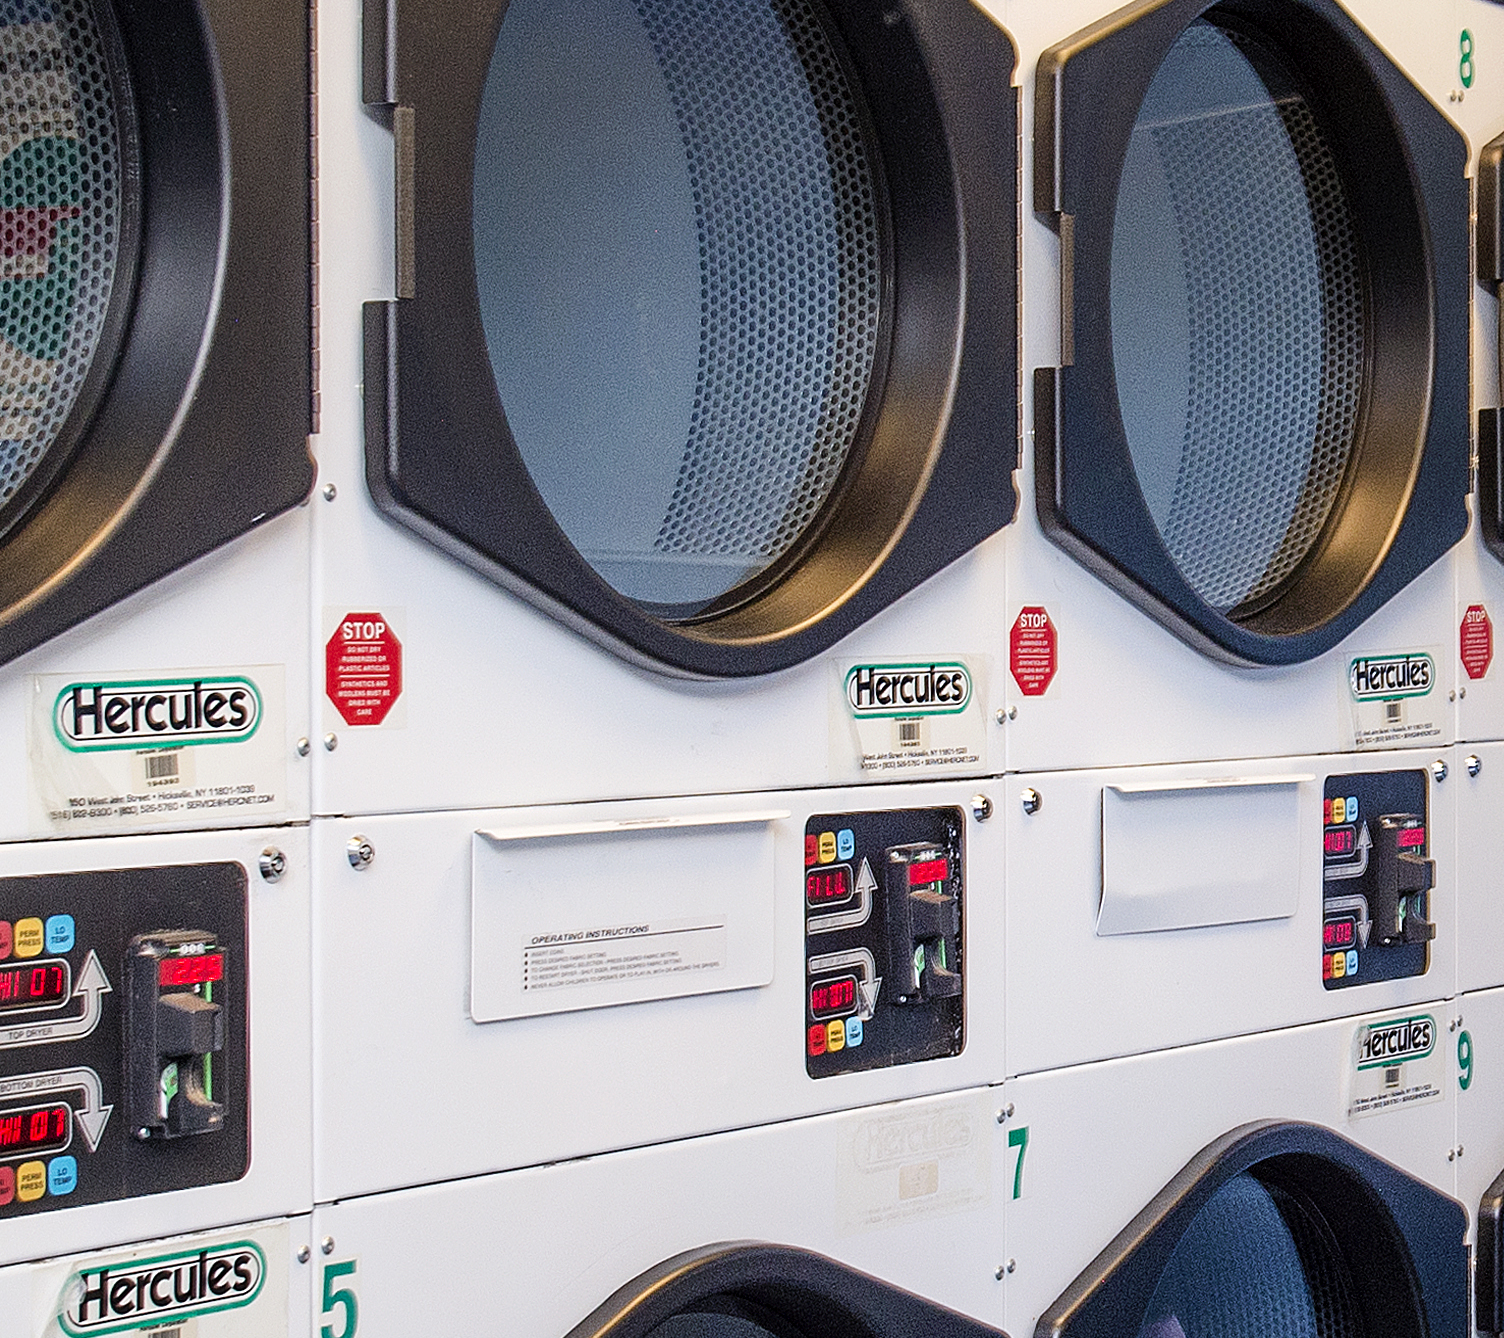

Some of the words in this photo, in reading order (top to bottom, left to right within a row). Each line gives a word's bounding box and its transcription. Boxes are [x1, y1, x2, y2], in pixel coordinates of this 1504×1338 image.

[1458, 29, 1475, 89] 8
[342, 621, 386, 640] STOP
[1020, 613, 1048, 628] STOP
[1466, 610, 1486, 623] STOP
[856, 665, 963, 706] Hercules
[1356, 654, 1430, 691] Hercules
[72, 681, 248, 736] Hercules
[531, 931, 584, 945] OPERATING
[585, 925, 650, 939] INSTRUCTIONS
[8, 1030, 25, 1040] TOP
[26, 1027, 53, 1038] DRYER
[1457, 1032, 1473, 1091] 9
[1008, 1128, 1028, 1200] 7
[78, 1250, 252, 1323] Hercules
